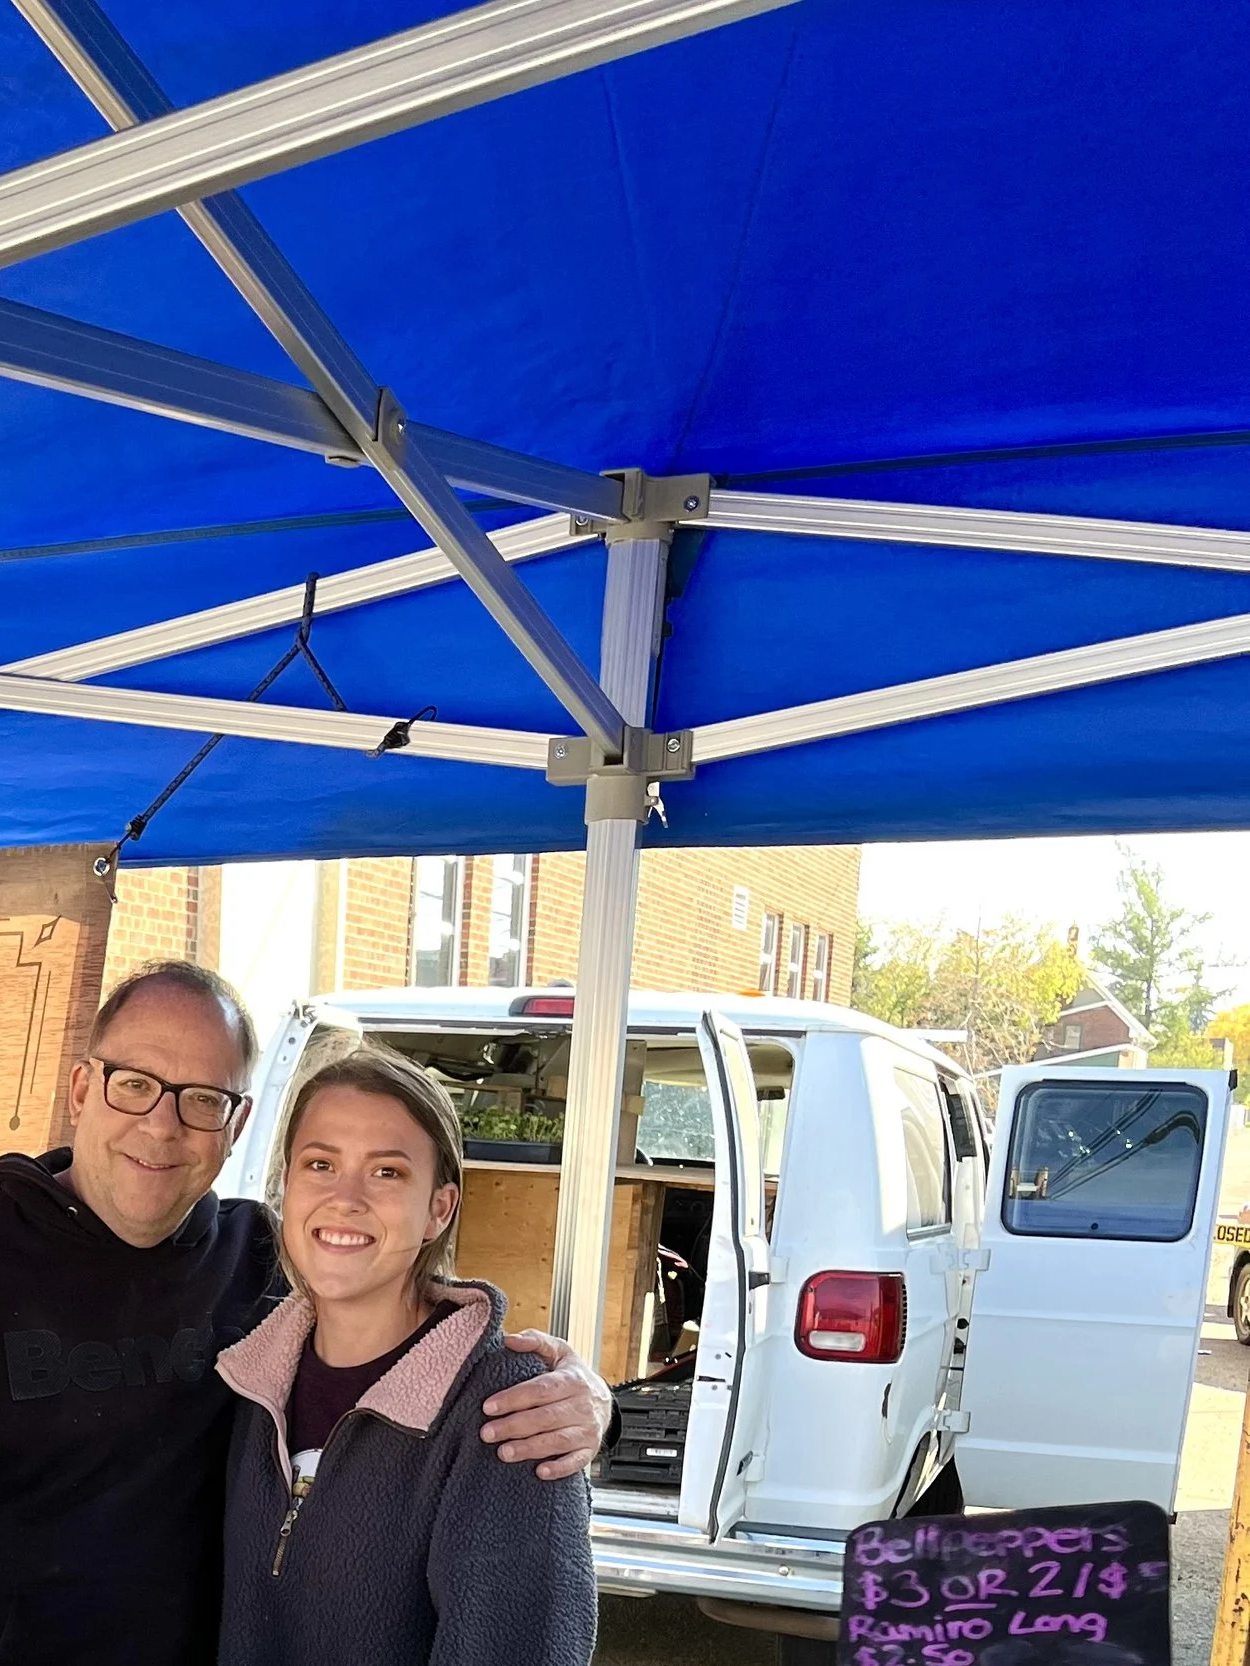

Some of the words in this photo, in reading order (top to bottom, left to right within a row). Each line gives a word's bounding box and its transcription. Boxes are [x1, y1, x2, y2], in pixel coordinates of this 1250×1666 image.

[852, 1569, 931, 1611] $3
[940, 1568, 1020, 1601] OR
[847, 1614, 994, 1643] Ramiro
[1008, 1610, 1108, 1643] Long
